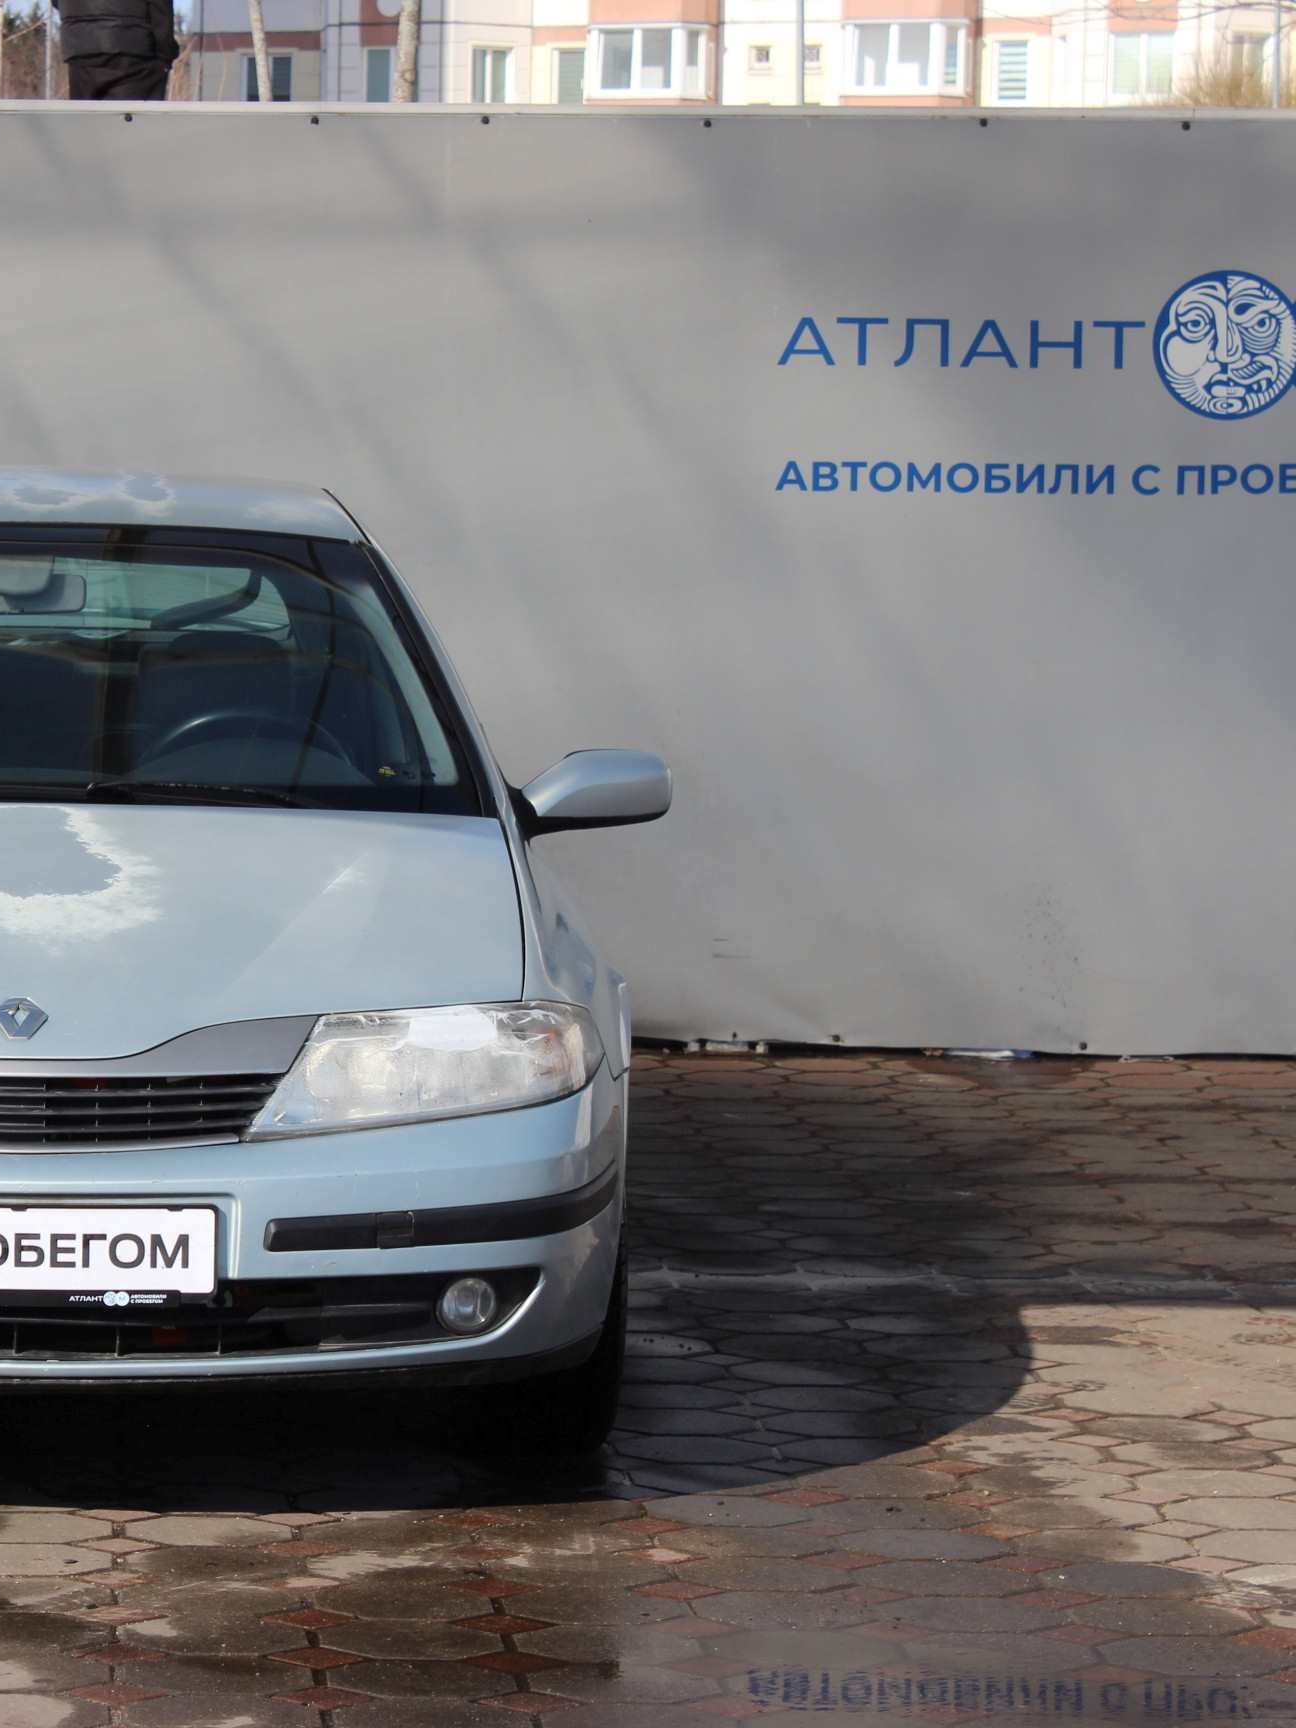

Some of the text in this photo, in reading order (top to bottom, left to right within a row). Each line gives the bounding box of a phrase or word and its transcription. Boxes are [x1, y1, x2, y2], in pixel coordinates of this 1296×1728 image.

[777, 317, 1146, 369] АТЛАНТ
[775, 461, 1115, 494] АВТОМОБИЛИ
[1132, 464, 1160, 495] С
